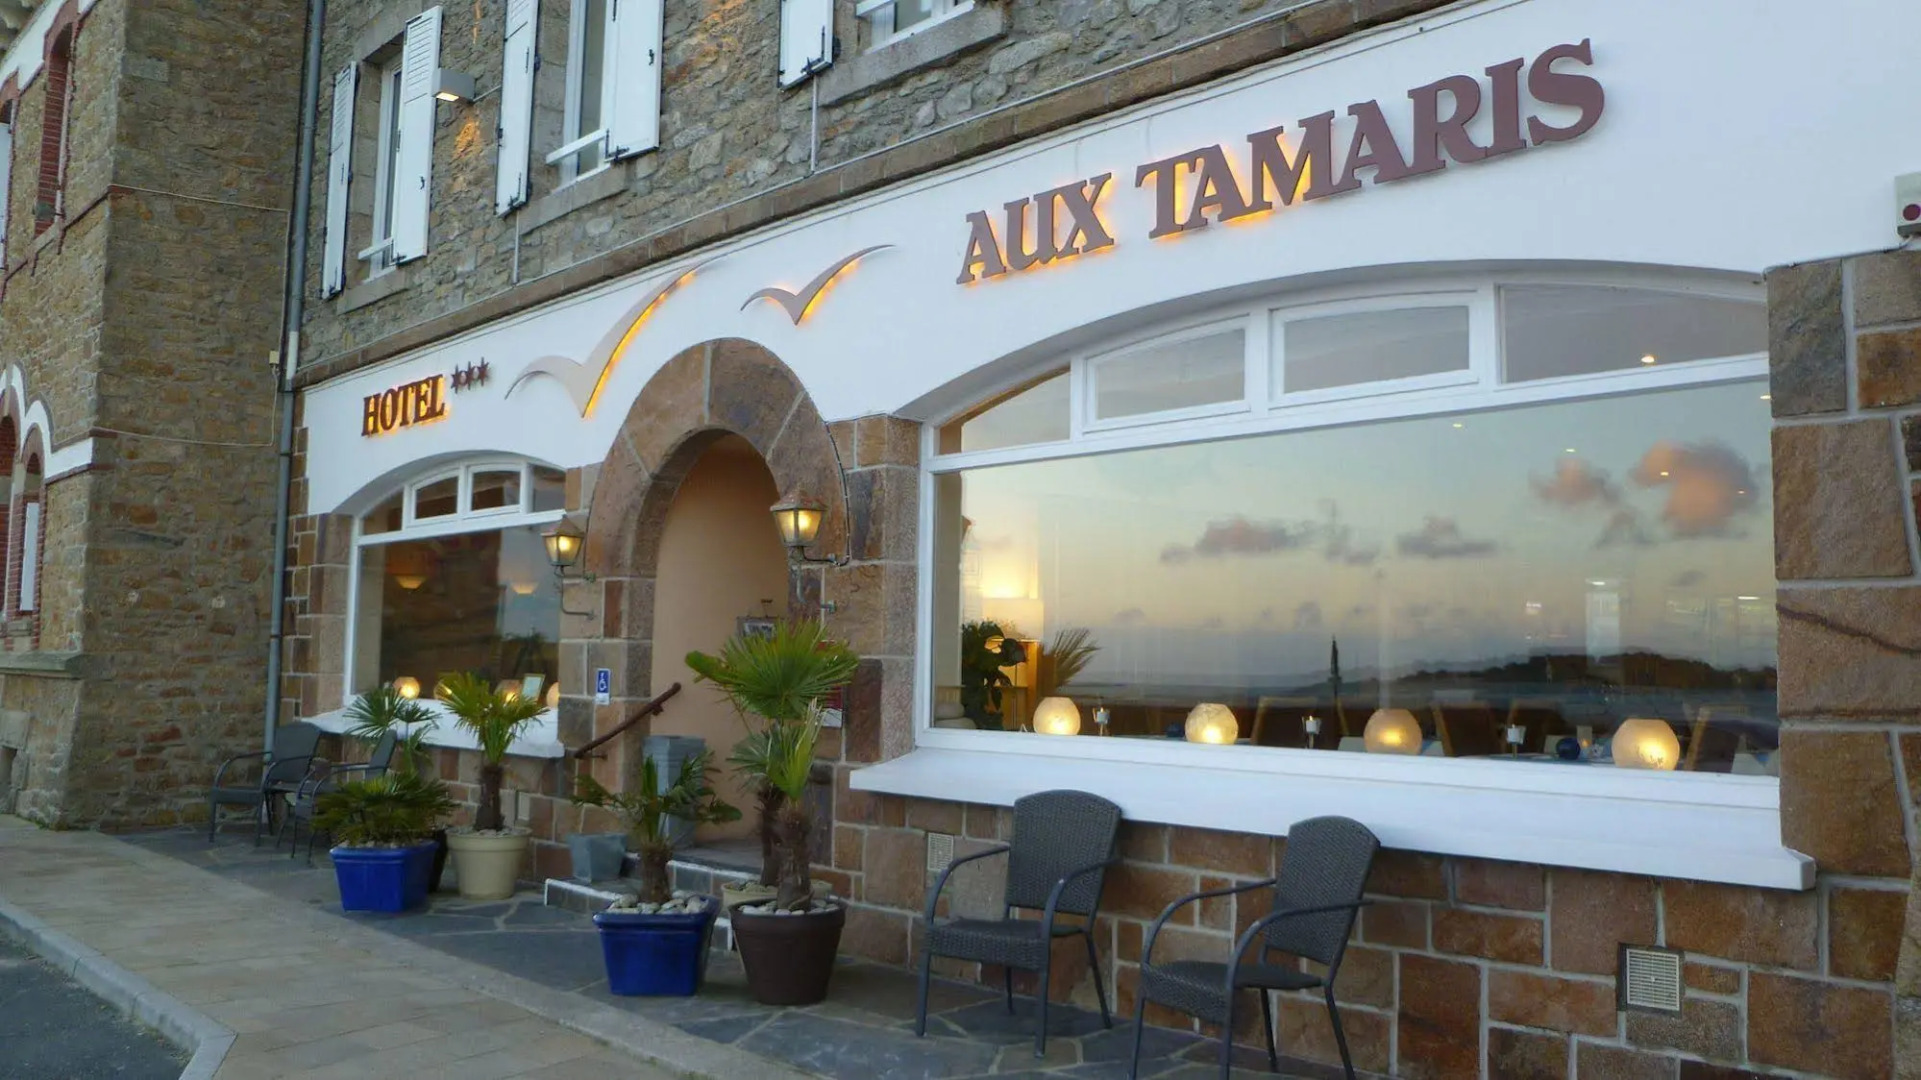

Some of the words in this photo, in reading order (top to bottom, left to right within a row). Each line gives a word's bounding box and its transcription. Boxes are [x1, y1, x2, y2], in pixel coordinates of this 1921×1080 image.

[956, 172, 1115, 285] AUX
[1135, 37, 1605, 240] TAMARIS
[361, 373, 446, 437] HOTEL
